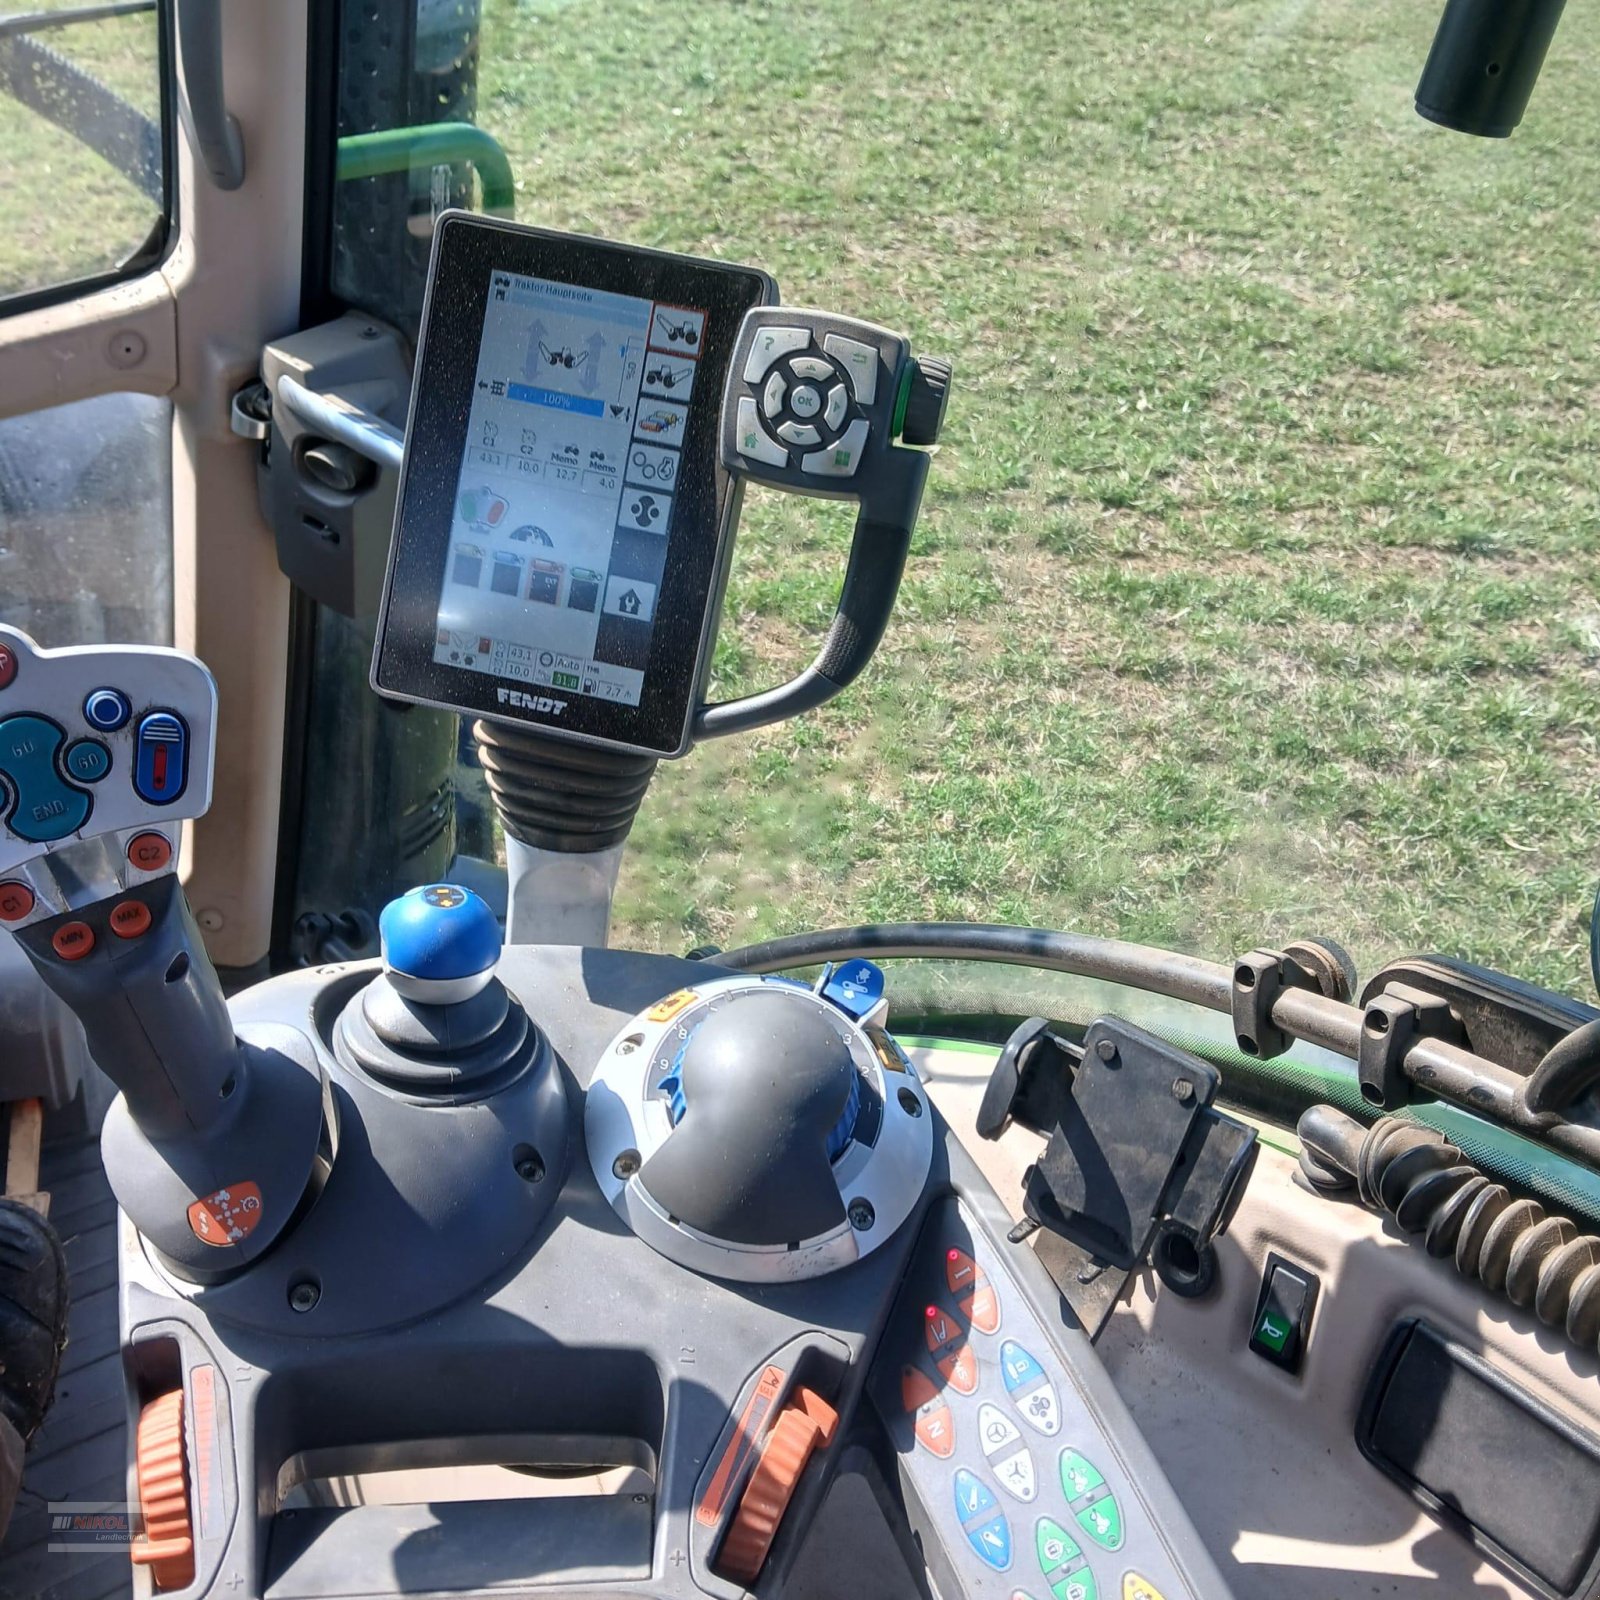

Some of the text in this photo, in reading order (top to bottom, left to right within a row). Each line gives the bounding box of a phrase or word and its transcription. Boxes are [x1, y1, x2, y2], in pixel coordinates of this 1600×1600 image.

[515, 279, 593, 302] Traktor Hauptseite
[543, 393, 571, 407] 100%
[797, 395, 813, 407] OK
[483, 436, 495, 447] C1
[520, 445, 534, 455] C2
[551, 453, 578, 466] Memo
[518, 460, 539, 473] 10.0
[589, 460, 617, 474] Memo
[556, 468, 577, 481] 12.7
[511, 647, 531, 660] 43.1
[509, 664, 530, 677] 10.0
[557, 658, 580, 671] Auto
[497, 688, 568, 715] FENDT
[77, 752, 99, 770] GO
[32, 800, 65, 821] END
[137, 847, 160, 862] C2
[1, 897, 21, 912] C1
[116, 907, 142, 923] MAX
[60, 930, 84, 946] MIN
[678, 1028, 688, 1040] 8
[842, 1034, 852, 1045] 3
[659, 1058, 669, 1070] 9
[860, 1066, 870, 1078] 2
[927, 1420, 945, 1439] N
